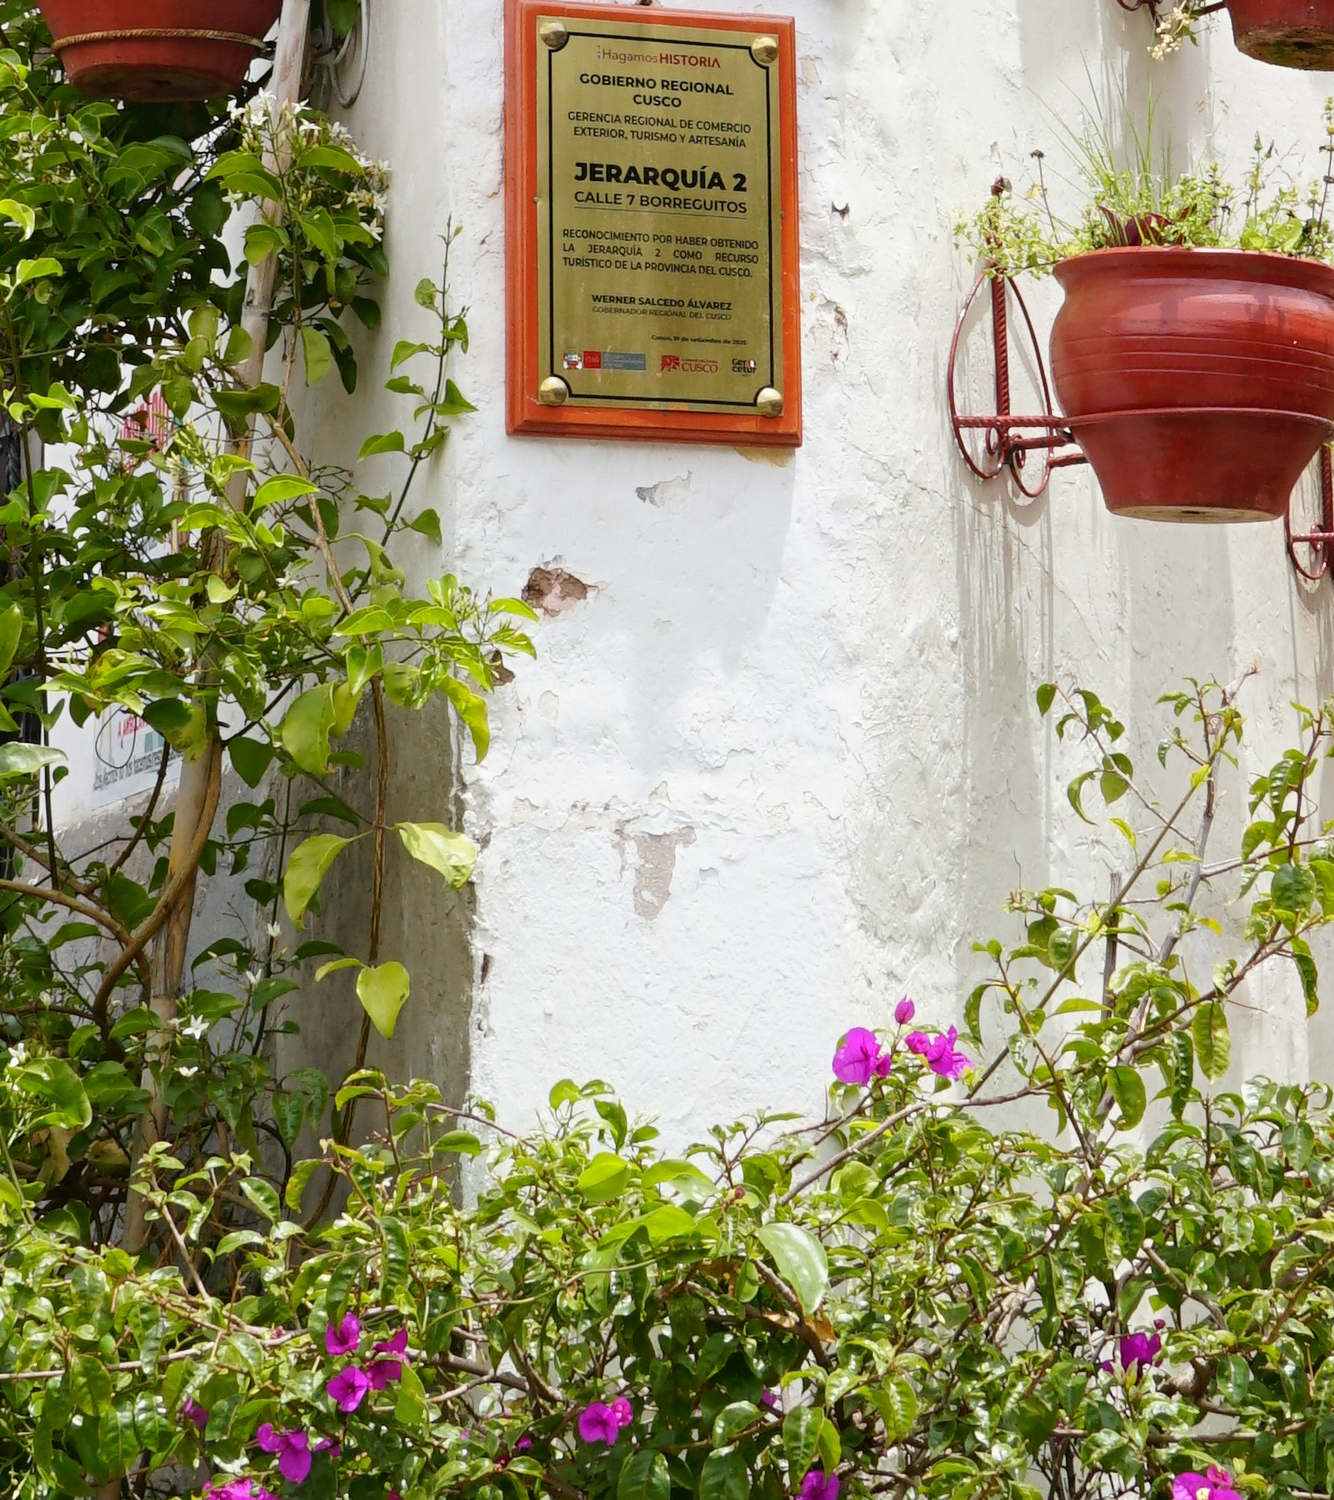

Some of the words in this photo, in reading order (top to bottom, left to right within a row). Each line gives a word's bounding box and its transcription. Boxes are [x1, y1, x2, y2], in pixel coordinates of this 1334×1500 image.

[580, 73, 656, 89] GOBIERNO
[661, 79, 734, 95] REGIONAL
[633, 94, 682, 108] CUSCO
[568, 111, 621, 124] GERENCIA
[624, 115, 677, 128] REGIONAL
[680, 119, 693, 129] DE
[696, 120, 751, 134] COMERCIO
[573, 127, 627, 140] EXTERIOR,
[630, 130, 677, 142] TURISMO
[680, 134, 686, 143] Y
[688, 135, 746, 148] ARTESANÍA
[574, 162, 727, 191] JERARQUÍA
[732, 173, 747, 192] 2
[574, 191, 622, 205] CALLE
[627, 194, 635, 206] 7
[640, 195, 747, 214] BORREGUITOS
[562, 228, 650, 242] RECONOCIMIENTO
[652, 234, 672, 244] POR
[675, 235, 707, 246] HABER
[710, 238, 759, 250] OBTENIDO
[562, 243, 575, 252] LA
[587, 243, 643, 257] JERARQUÍA
[654, 248, 661, 257] 2
[673, 249, 702, 260] COMO
[715, 252, 759, 264] RECURSO
[562, 255, 612, 268] TURÍSTICO
[614, 260, 627, 270] DE
[630, 261, 643, 271] LA
[645, 262, 696, 273] PROVINCIA
[698, 265, 717, 275] DEL
[718, 266, 753, 278] CUSCO.
[591, 294, 636, 305] WERNER
[638, 296, 685, 308] SALCEDO
[687, 298, 732, 310] ÁLVAREZ
[681, 362, 719, 374] CUSCO
